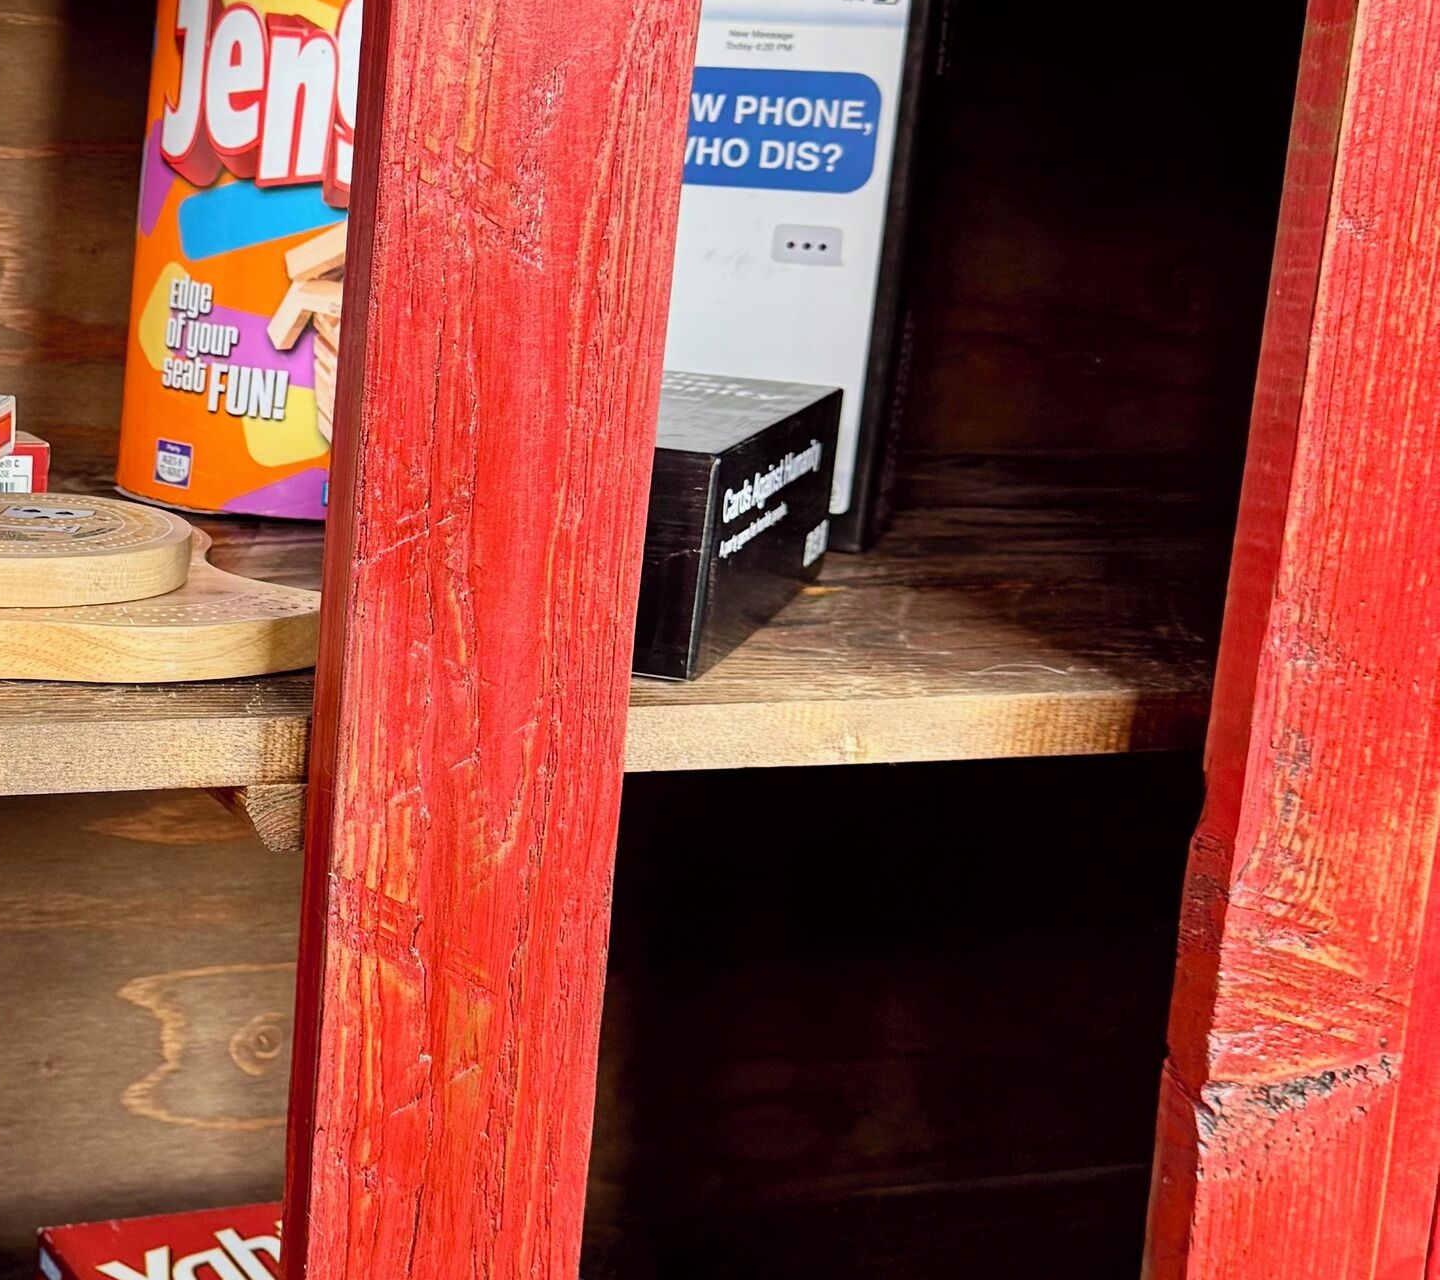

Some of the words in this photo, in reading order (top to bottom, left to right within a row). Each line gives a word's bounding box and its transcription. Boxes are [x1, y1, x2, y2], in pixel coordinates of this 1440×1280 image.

[751, 30, 794, 41] Message
[734, 94, 874, 137] PHONE,
[759, 140, 844, 172] DIS?
[169, 277, 212, 318] Edge
[165, 313, 187, 349] of
[186, 319, 239, 359] your
[162, 357, 206, 393] seat
[207, 362, 289, 421] FUN!
[723, 479, 753, 524] Cards
[751, 459, 785, 509] Against
